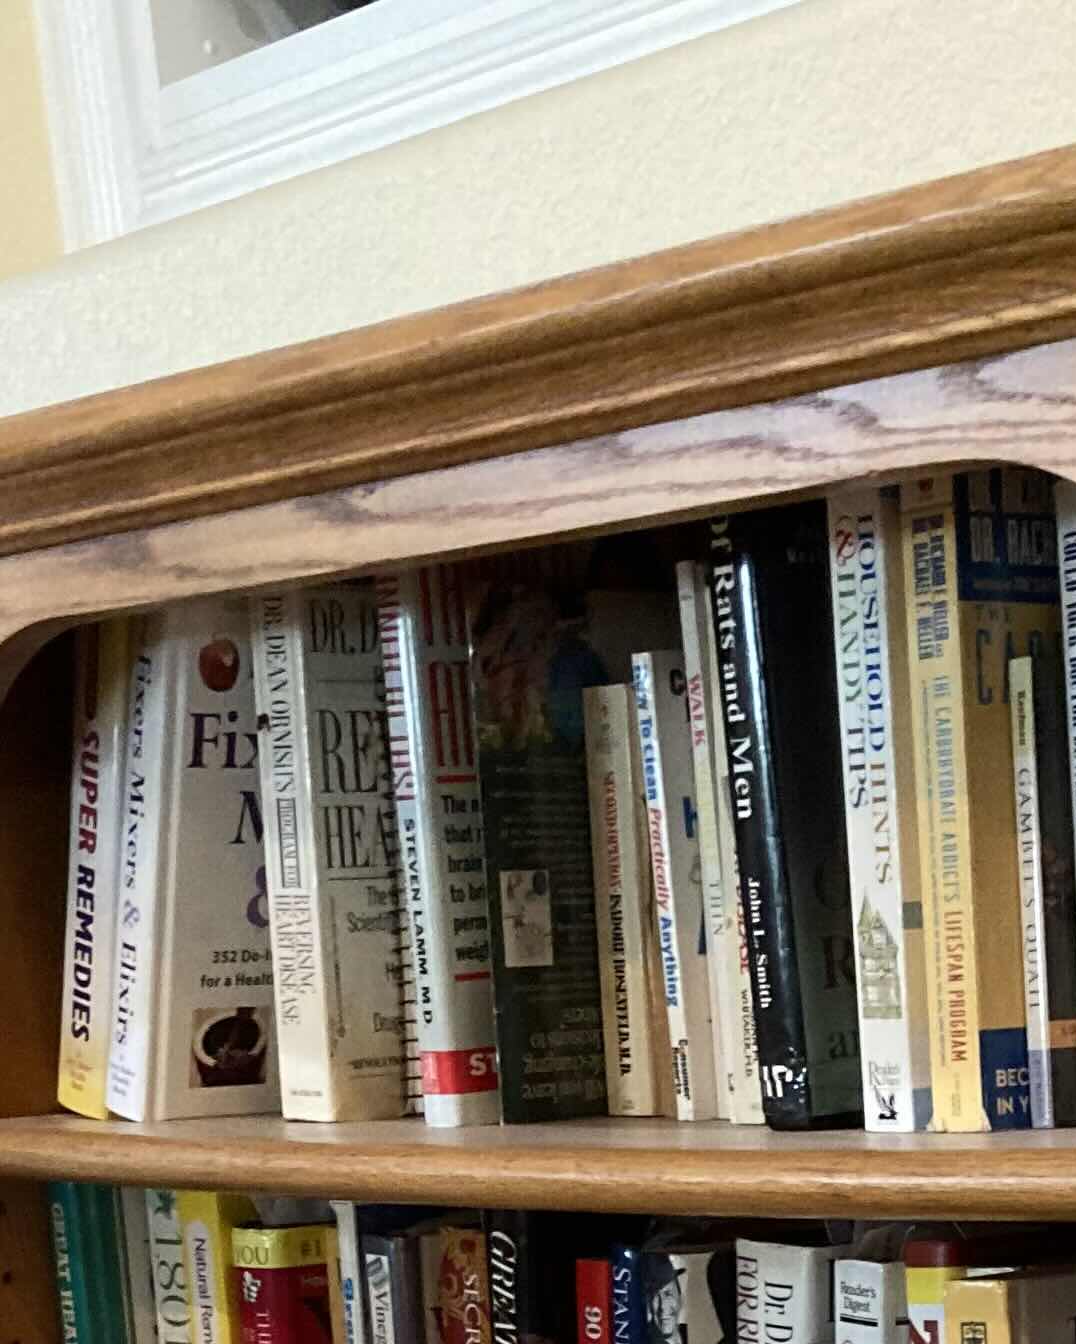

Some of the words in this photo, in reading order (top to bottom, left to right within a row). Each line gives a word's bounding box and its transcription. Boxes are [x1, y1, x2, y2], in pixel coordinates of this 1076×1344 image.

[713, 564, 737, 650] Rats
[857, 515, 885, 752] HOUSEHOLD
[688, 673, 705, 746] WALK
[724, 662, 747, 724] and
[78, 731, 99, 854] SUPER
[731, 738, 754, 820] Men
[870, 763, 893, 885] HINTS
[402, 818, 421, 901] STEVEN
[413, 910, 428, 975] LAMM
[71, 864, 95, 1042] REMEDIES
[213, 950, 237, 964] 352
[748, 878, 763, 924] John
[756, 954, 773, 1008] Smith
[52, 1203, 72, 1282] GREAT
[737, 1255, 758, 1312] FOR
